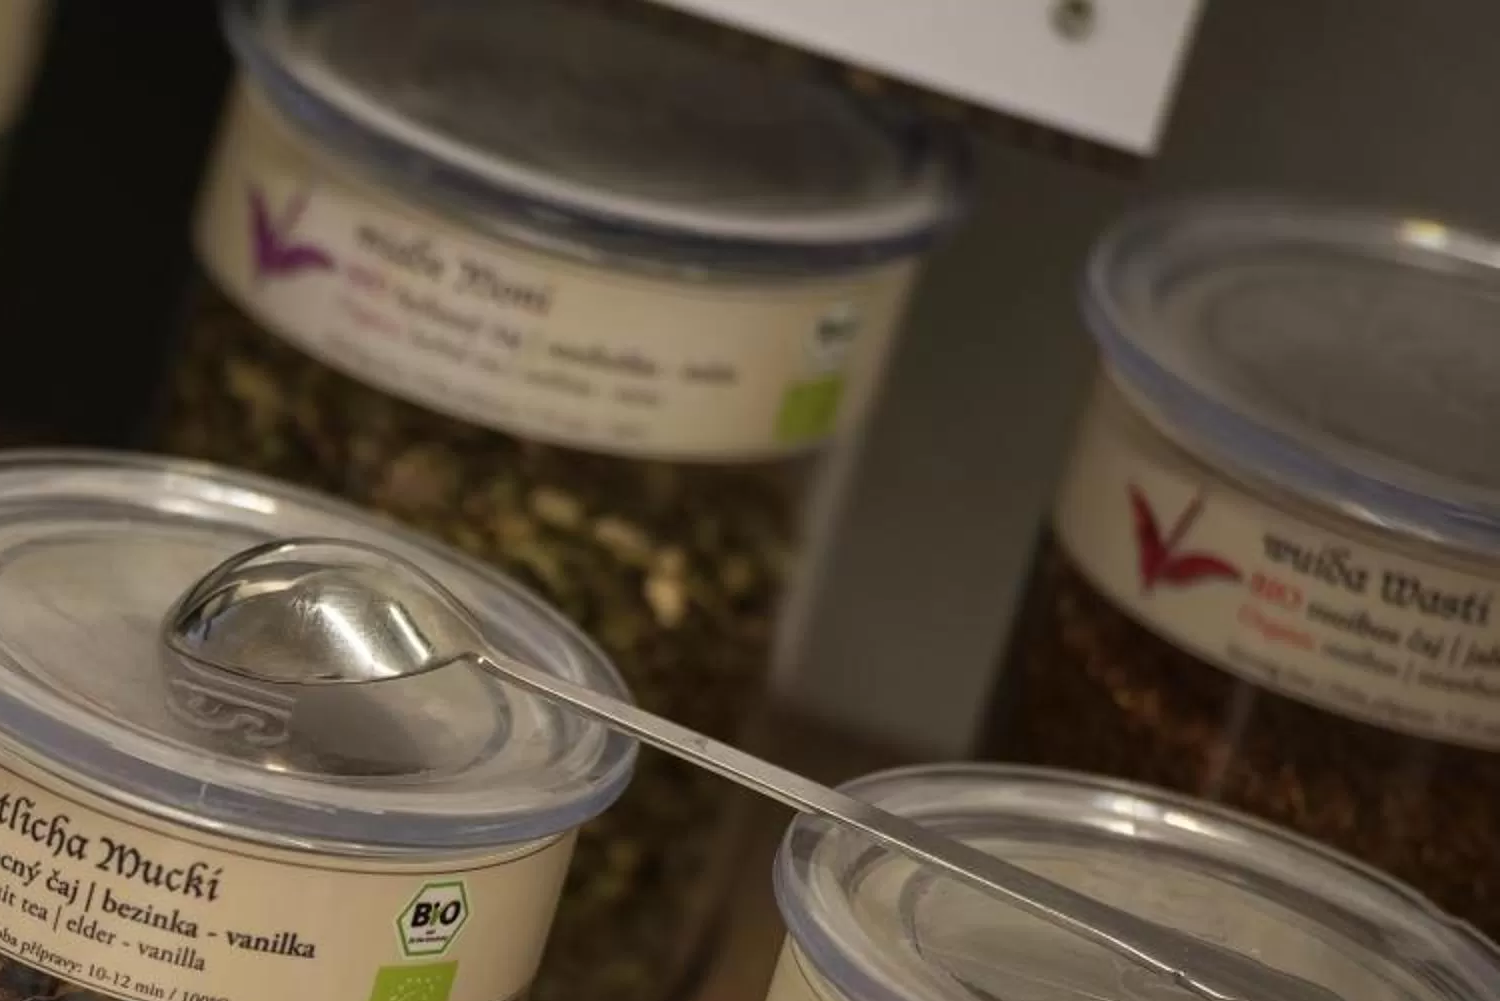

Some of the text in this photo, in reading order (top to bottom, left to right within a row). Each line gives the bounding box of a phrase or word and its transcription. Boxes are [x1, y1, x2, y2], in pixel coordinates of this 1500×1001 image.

[96, 837, 224, 902] Mucki
[21, 899, 48, 921] tea
[66, 915, 117, 946] elder
[138, 941, 206, 972] vanilla
[45, 868, 80, 904] čaj
[102, 888, 198, 938] bezinka
[226, 931, 316, 959] vanilka
[88, 963, 131, 989] 10-12
[135, 982, 165, 999] min
